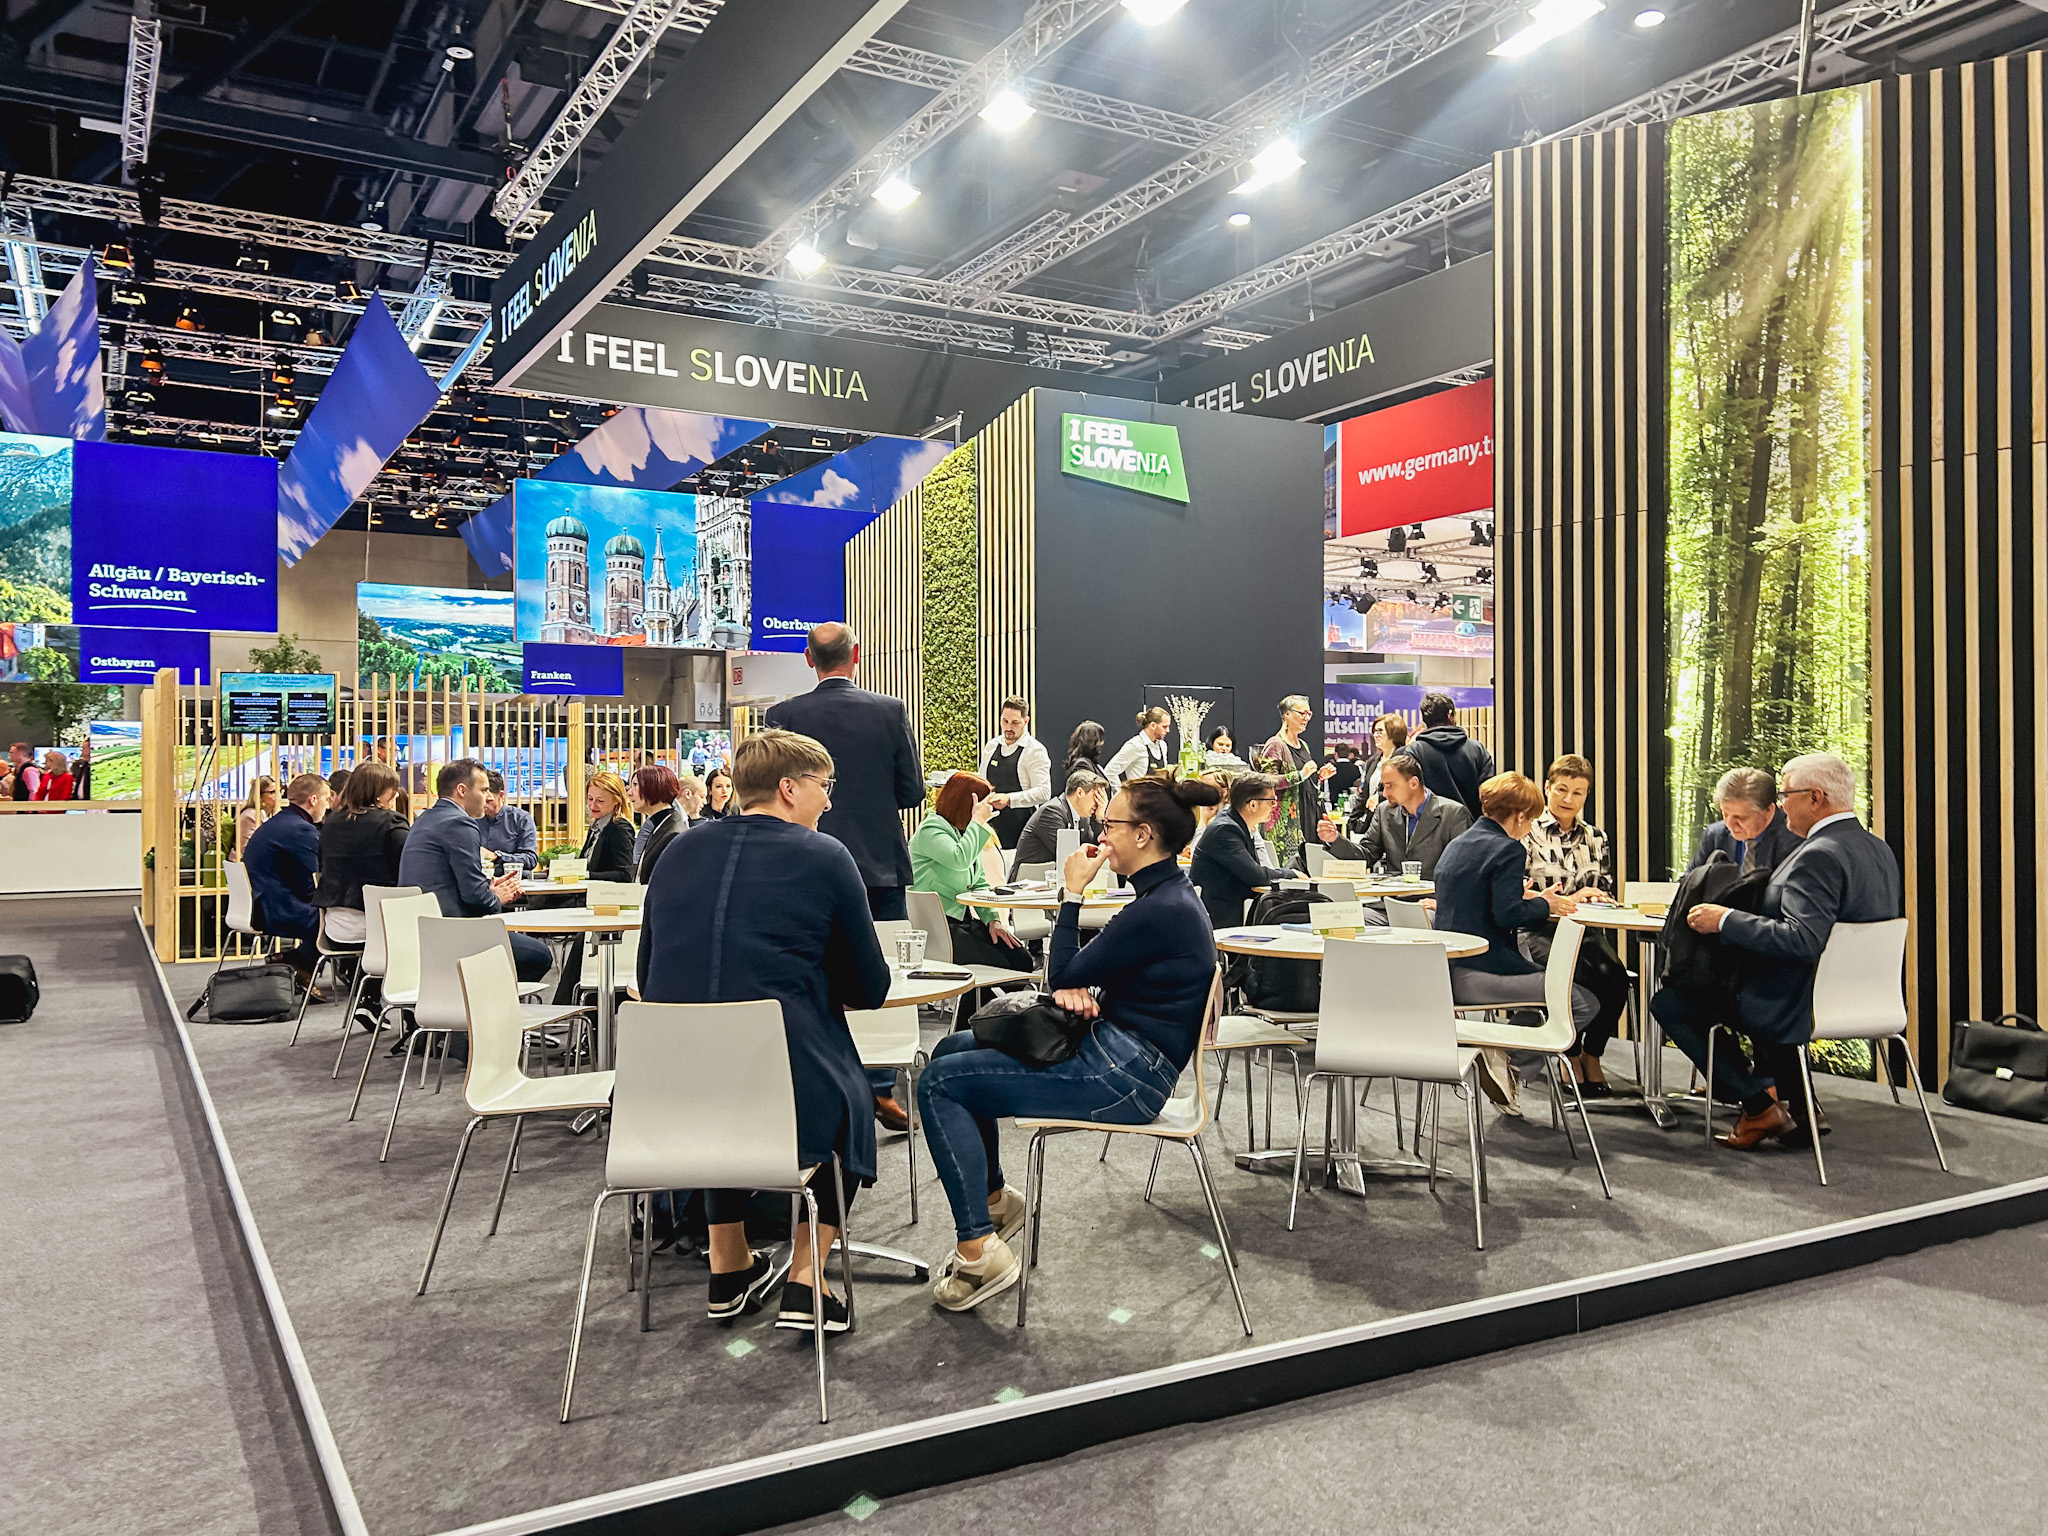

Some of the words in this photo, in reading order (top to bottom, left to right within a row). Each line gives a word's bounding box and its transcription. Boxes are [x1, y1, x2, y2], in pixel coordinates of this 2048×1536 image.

[501, 306, 508, 343] I
[507, 281, 533, 336] FEEL
[534, 209, 598, 307] SLOVENIA
[557, 330, 575, 364] I
[585, 332, 679, 378] FEEL
[689, 347, 869, 402] SLOVENIA
[1250, 333, 1376, 404] SLOVENIA
[1069, 418, 1081, 442] I
[1083, 420, 1134, 447] FEEL
[1070, 443, 1172, 475] SLOVENIA
[88, 563, 152, 583] Allgäu
[154, 566, 165, 582] /
[167, 567, 266, 587] Bayerisch-
[88, 583, 188, 602] Schwaben
[762, 616, 822, 631] Oberbay
[90, 656, 156, 669] Ostbayern
[530, 670, 573, 680] Franken
